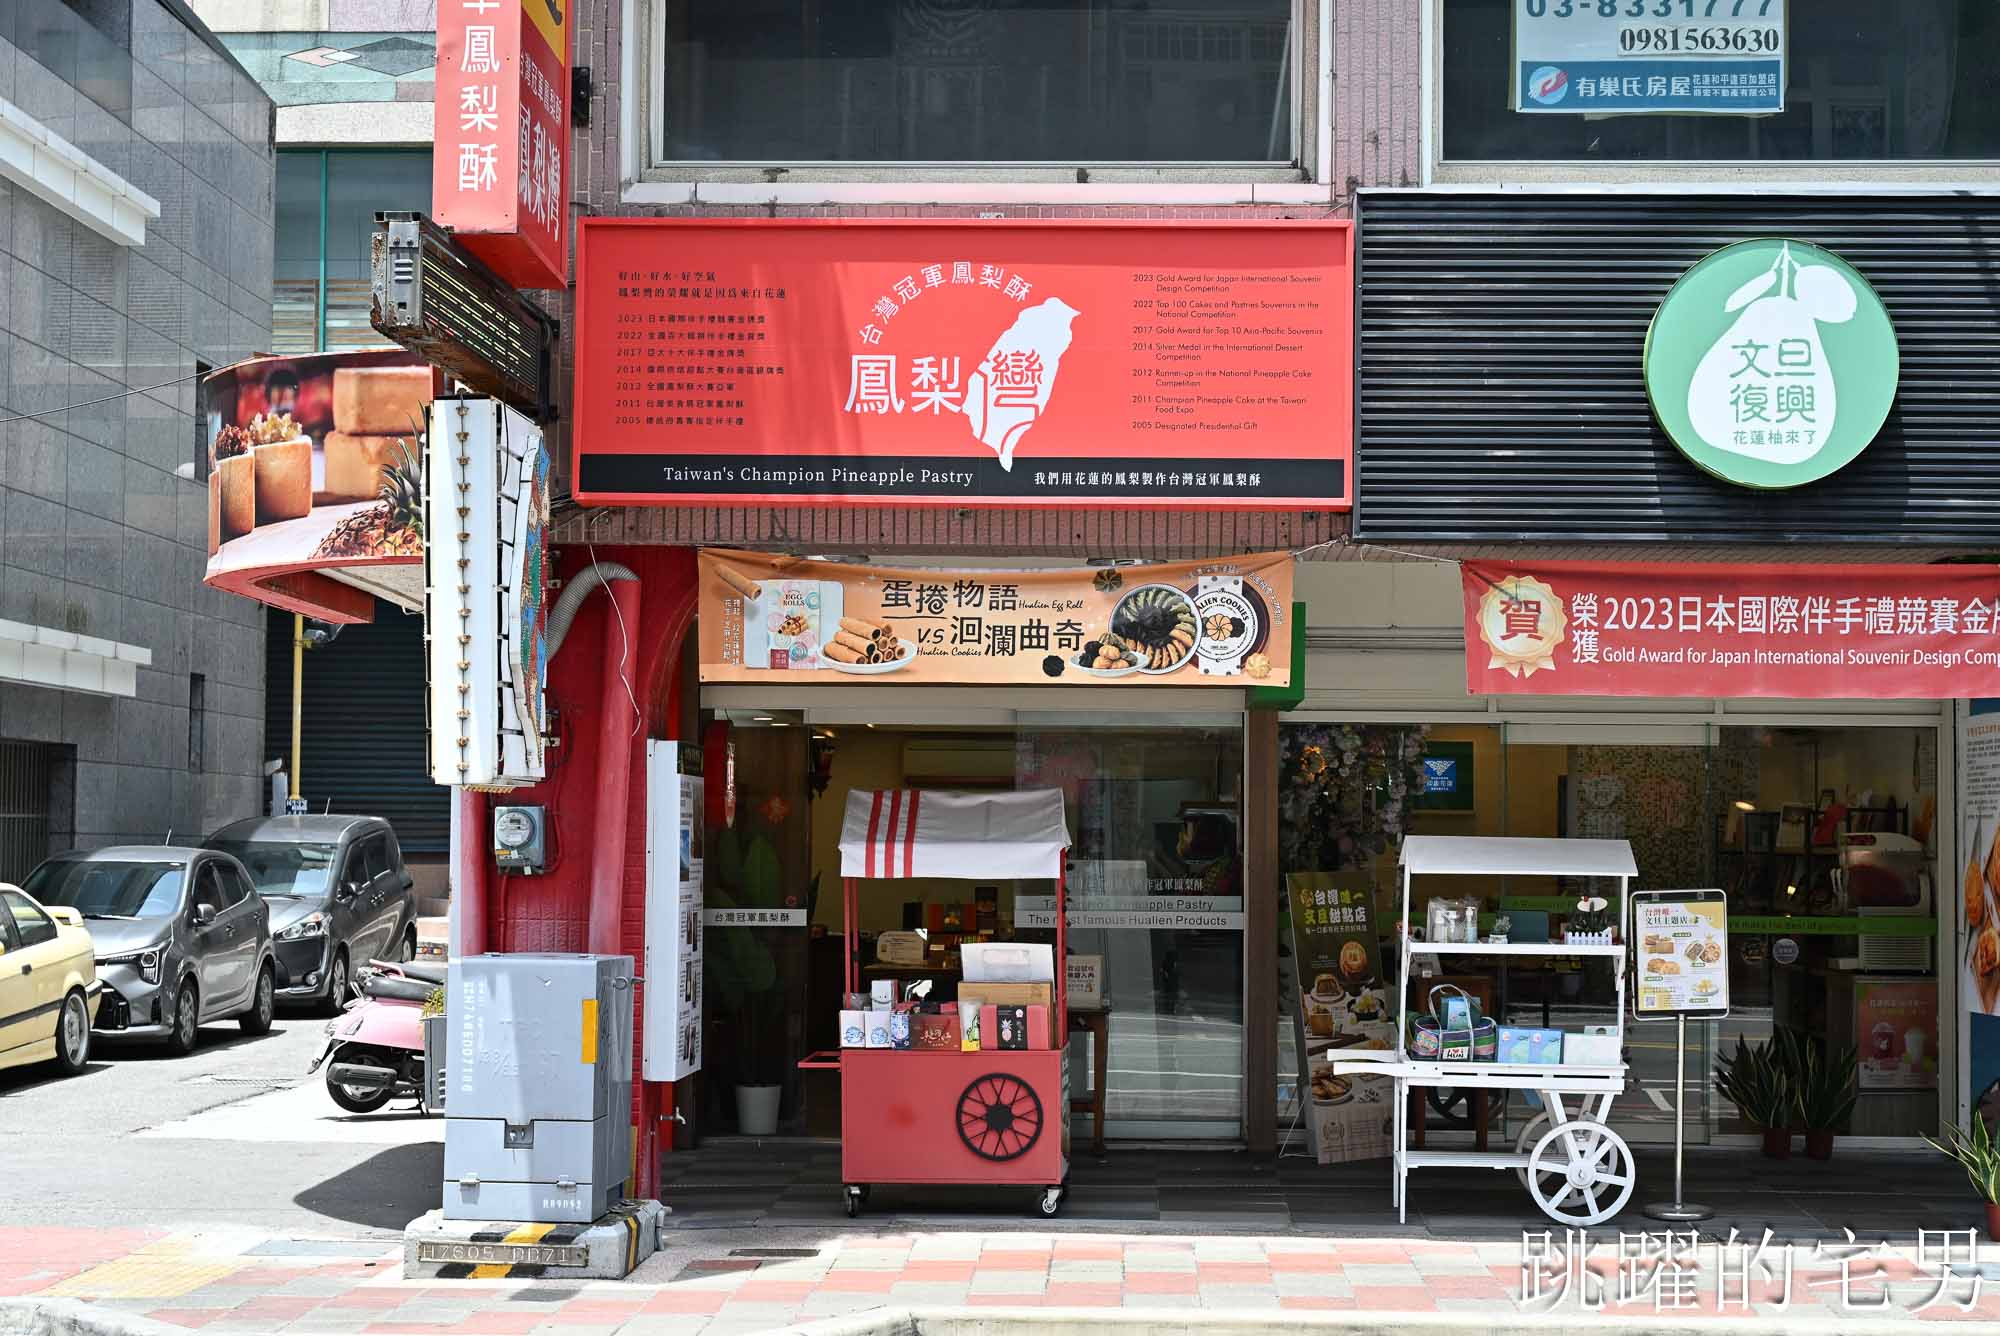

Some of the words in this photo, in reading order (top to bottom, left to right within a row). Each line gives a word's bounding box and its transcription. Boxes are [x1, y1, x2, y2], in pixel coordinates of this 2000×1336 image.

[1620, 28, 1779, 51] 0981563630
[1575, 76, 1692, 97] 有巢氏房屋
[1133, 274, 1153, 282] 2023
[1157, 274, 1175, 282] Gold
[1178, 274, 1200, 282] Award
[1216, 275, 1239, 284] Japan
[1290, 275, 1321, 283] Souvenir
[1156, 285, 1182, 293] Design
[1184, 285, 1229, 293] Competition
[859, 261, 1033, 345] 台灣冠軍鳳梨酥
[1133, 300, 1152, 308] 2022
[1157, 301, 1169, 309] Top
[617, 314, 642, 323] 2023
[1190, 311, 1236, 319] Competition
[1133, 326, 1152, 334] 2017
[1216, 327, 1229, 336] Top
[617, 332, 642, 341] 2022
[616, 349, 642, 357] 2017
[1155, 353, 1201, 361] Competition
[1729, 338, 1816, 378] 文旦
[616, 366, 641, 374] 2014
[1155, 370, 1194, 378] Runner-up
[1253, 370, 1290, 379] Pineapple
[616, 383, 641, 391] 2012
[1155, 380, 1200, 388] Competition
[616, 400, 640, 408] 2011
[1155, 396, 1194, 405] Champion
[1196, 397, 1233, 405] Pineapple
[1729, 384, 1816, 423] 復興
[1176, 406, 1194, 415] Expo
[615, 417, 640, 425] 2005
[1155, 422, 1197, 431] Designated
[1733, 430, 1817, 446] 花蓮柚來了
[663, 466, 734, 481] Taiwan's
[740, 467, 825, 486] Champion
[831, 468, 915, 487] Pineapple
[921, 469, 974, 488] Pastry
[1034, 472, 1262, 487] 我們用花蓮的鳳梨製作台灣冠軍鳳梨酥
[881, 579, 1018, 614] 蛋捲物語
[1018, 599, 1050, 609] Hualien
[1052, 599, 1064, 612] Egg
[1066, 599, 1083, 609] Roll
[1220, 596, 1249, 621] COOKIES
[1499, 599, 1543, 641] 賀
[1572, 593, 1599, 664] 榮獲
[951, 616, 1085, 656] 洄瀾曲奇
[917, 647, 949, 657] Hualien
[951, 647, 982, 657] Cookies
[1603, 645, 1635, 662] Gold
[1638, 646, 1684, 663] Award
[1686, 646, 1708, 663] for
[1709, 647, 1751, 668] Japan
[1754, 647, 1843, 665] International
[1848, 648, 1909, 666] Souvenir
[1913, 649, 1962, 671] Design
[1176, 899, 1214, 912] Pastry
[715, 912, 790, 922] 台灣冠軍鳳梨酥
[1028, 914, 1050, 924] The
[1080, 915, 1126, 925] famous
[1129, 915, 1174, 925] Hualien
[1176, 915, 1227, 926] Products
[422, 1246, 495, 1260] H7605
